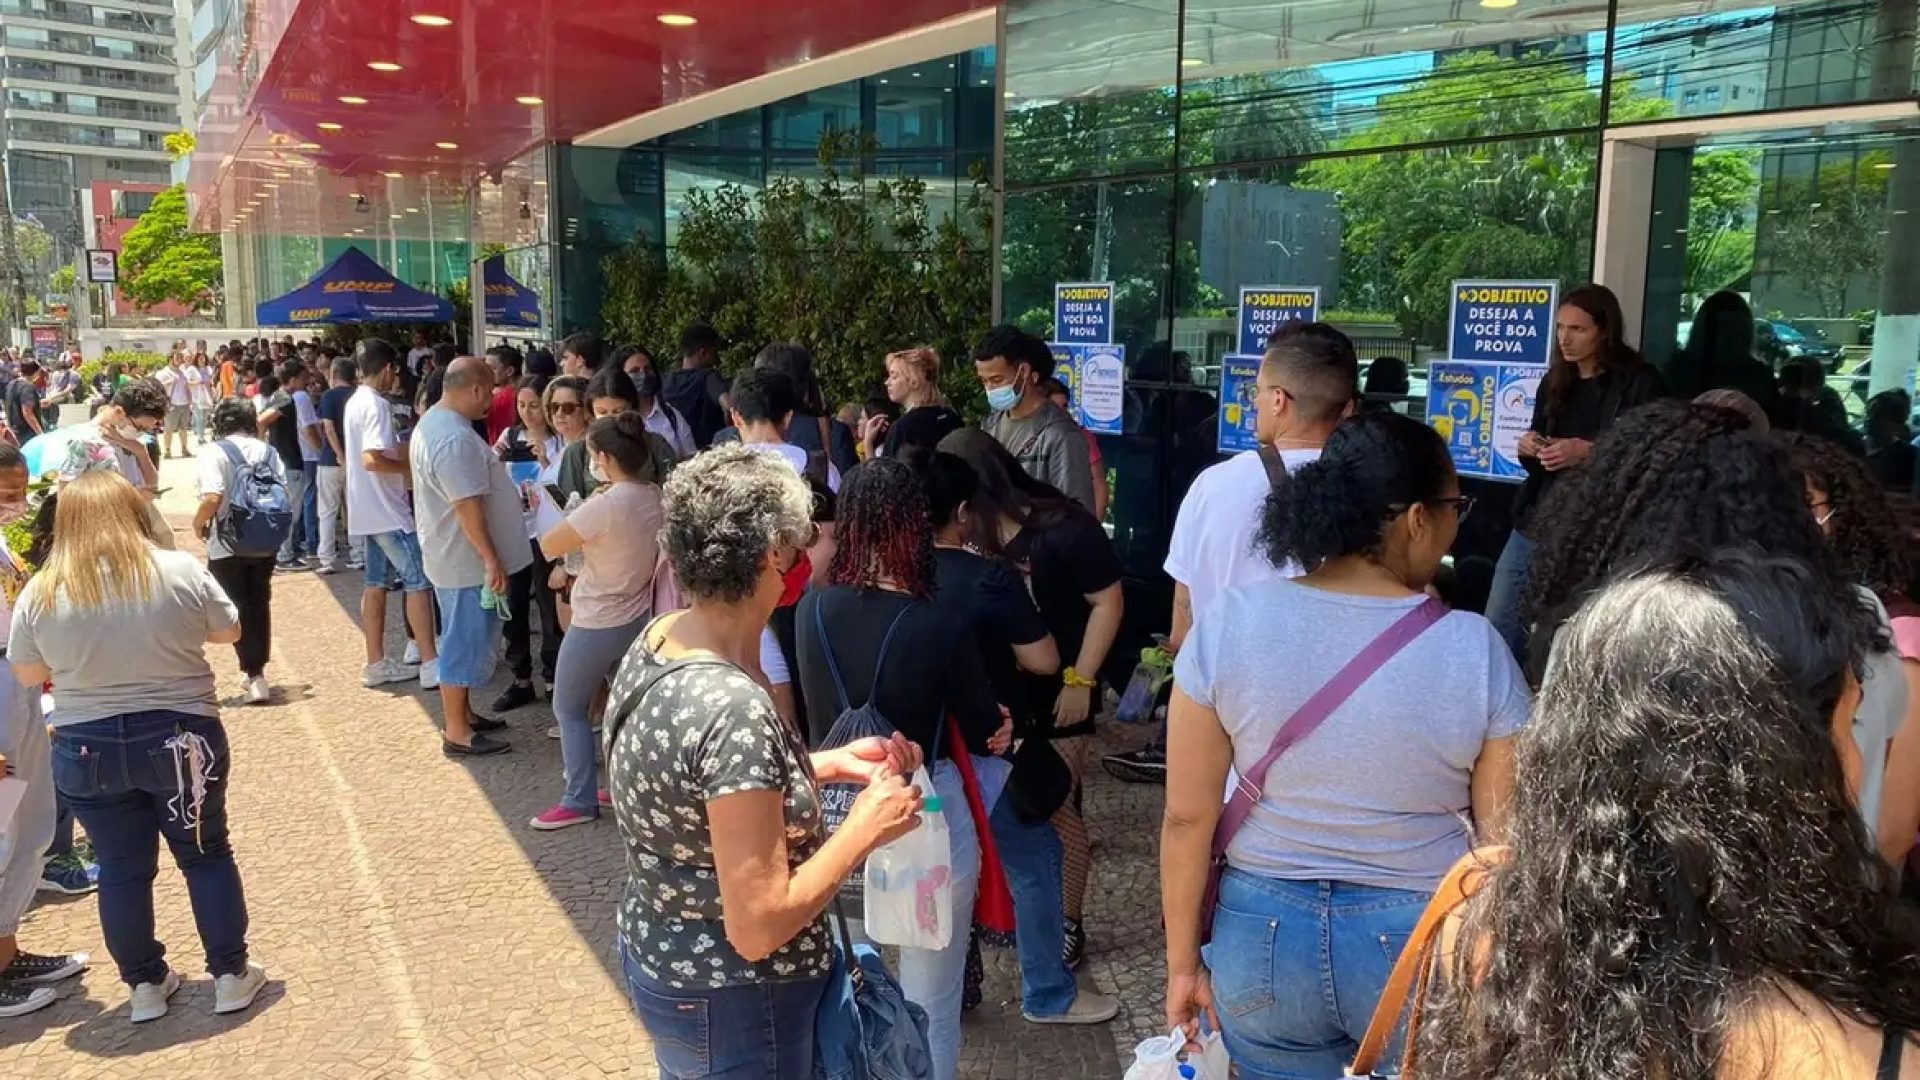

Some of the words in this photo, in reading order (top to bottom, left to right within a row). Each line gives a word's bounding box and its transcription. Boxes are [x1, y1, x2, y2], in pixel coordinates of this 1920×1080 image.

[1070, 289, 1109, 299] OBJETIVO
[1479, 289, 1548, 303] OBJETIVO
[1262, 295, 1312, 307] OBJETIVO
[1065, 303, 1093, 312] DESEJA
[1096, 303, 1102, 312] A
[1469, 307, 1518, 320] DESEJA
[1524, 308, 1534, 320] A
[290, 308, 331, 320] UNIP
[1063, 313, 1084, 324] VOCÊ
[1086, 315, 1104, 324] BOA
[1253, 310, 1290, 321] DESEJA
[1069, 327, 1097, 336] PROVA
[1464, 321, 1501, 336] VOCÊ
[1506, 325, 1537, 337] BOA
[1475, 339, 1524, 353] PROVA
[1480, 375, 1495, 444] OBJETIVO
